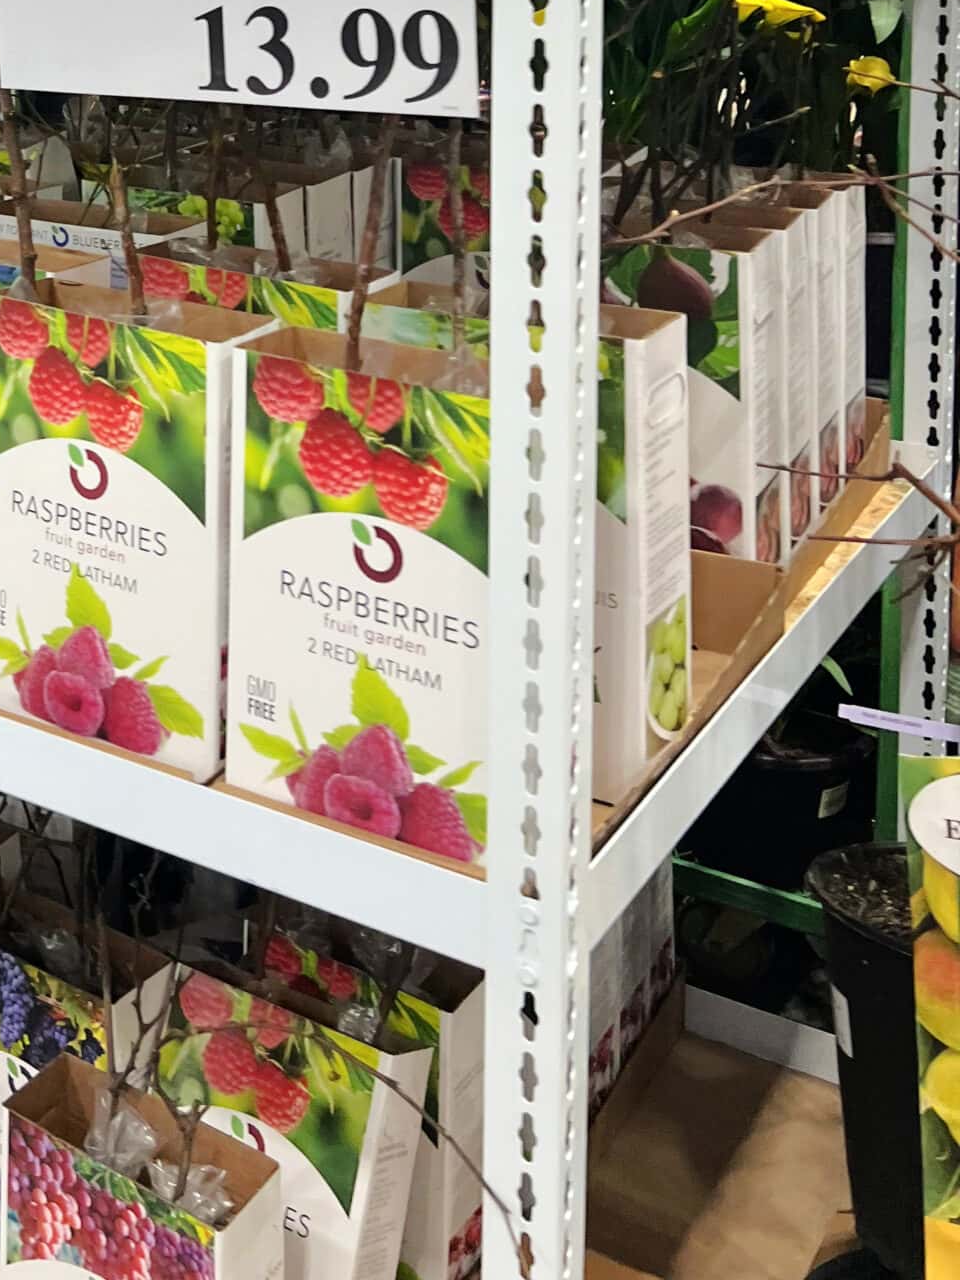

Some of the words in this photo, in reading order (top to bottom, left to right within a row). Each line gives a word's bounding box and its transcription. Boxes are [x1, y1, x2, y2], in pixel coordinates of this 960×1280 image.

[194, 4, 460, 104] 13.99
[11, 490, 168, 557] RASPBERRIES
[44, 528, 74, 549] fruit
[77, 539, 126, 563] garden
[32, 549, 41, 565] 2
[43, 551, 71, 573] RED
[76, 562, 138, 594] LATHAM
[280, 569, 480, 650] RASPBERRIES
[323, 613, 359, 638] fruit
[364, 626, 427, 657] garden
[306, 637, 317, 655] 2
[323, 640, 357, 665] RED
[364, 654, 442, 691] LATHAM
[247, 674, 277, 702] GMO
[248, 697, 276, 723] FREE
